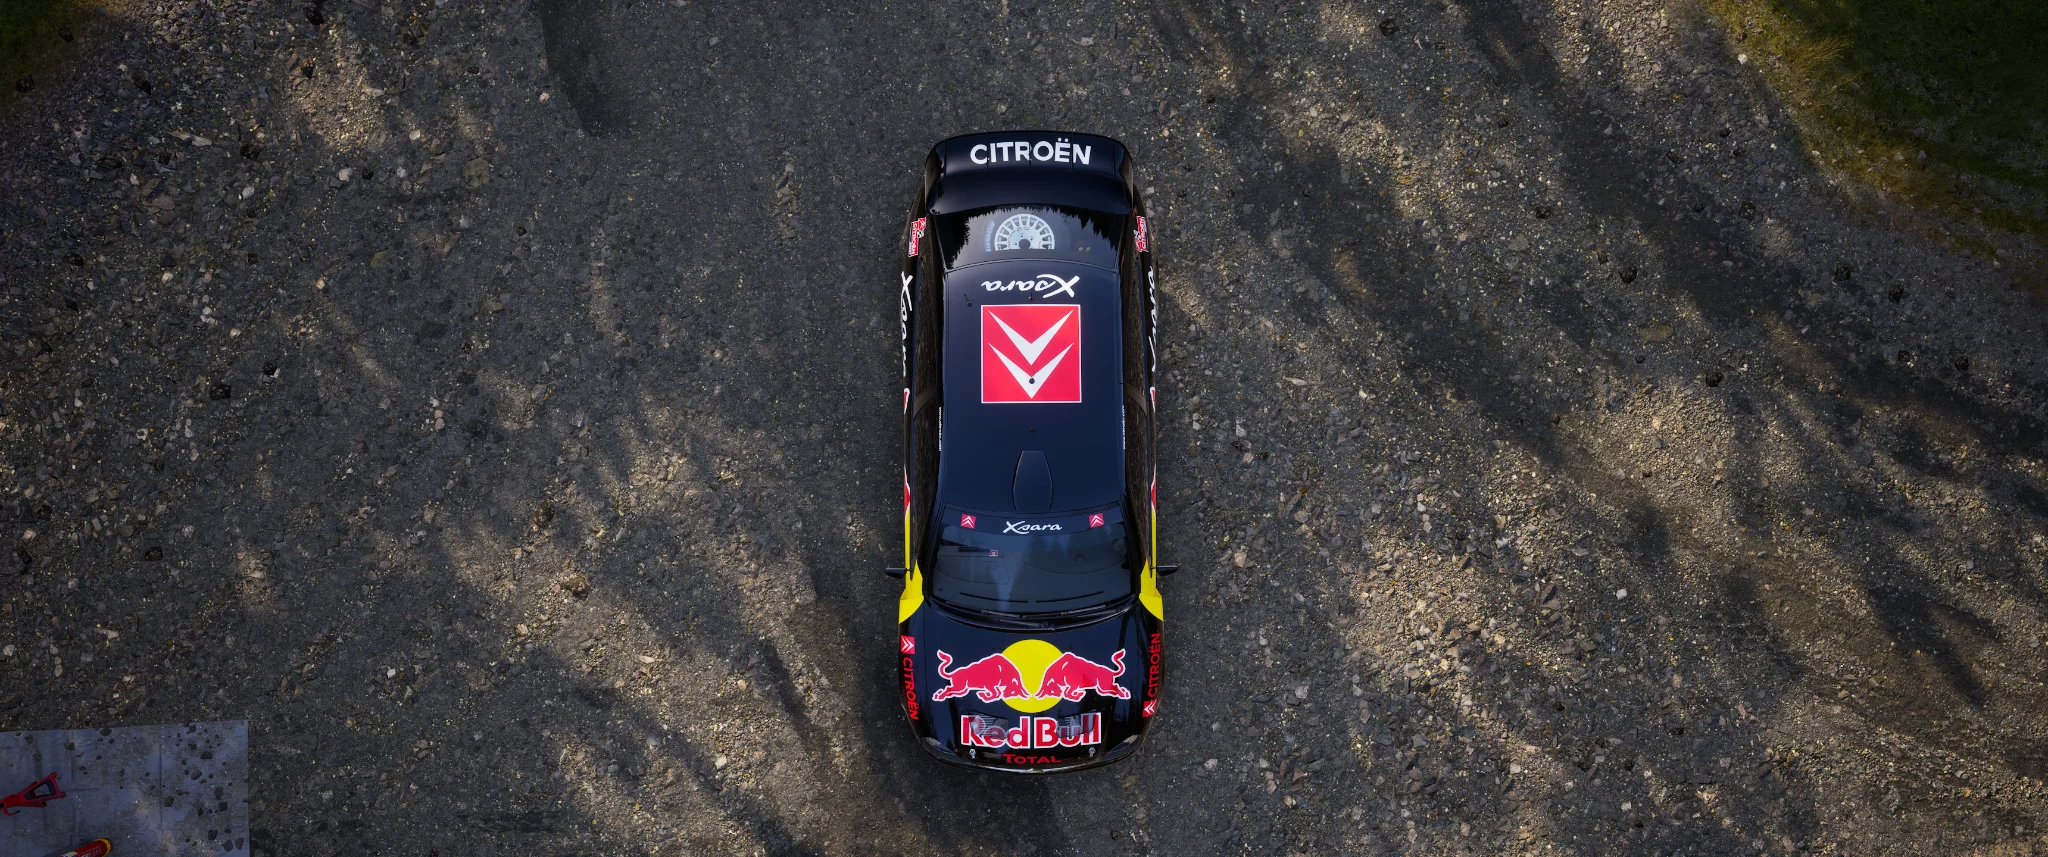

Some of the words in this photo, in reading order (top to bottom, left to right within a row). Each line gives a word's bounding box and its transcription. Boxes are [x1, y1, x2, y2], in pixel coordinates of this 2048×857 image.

[970, 137, 1092, 165] CITROËN
[981, 274, 1080, 298] Xsara
[1003, 520, 1063, 534] Xsara
[1147, 632, 1161, 697] CITROËN
[903, 657, 919, 721] CITROËN
[961, 715, 1029, 749] Red
[1034, 712, 1102, 749] Bull
[1002, 753, 1062, 764] TOTAL
